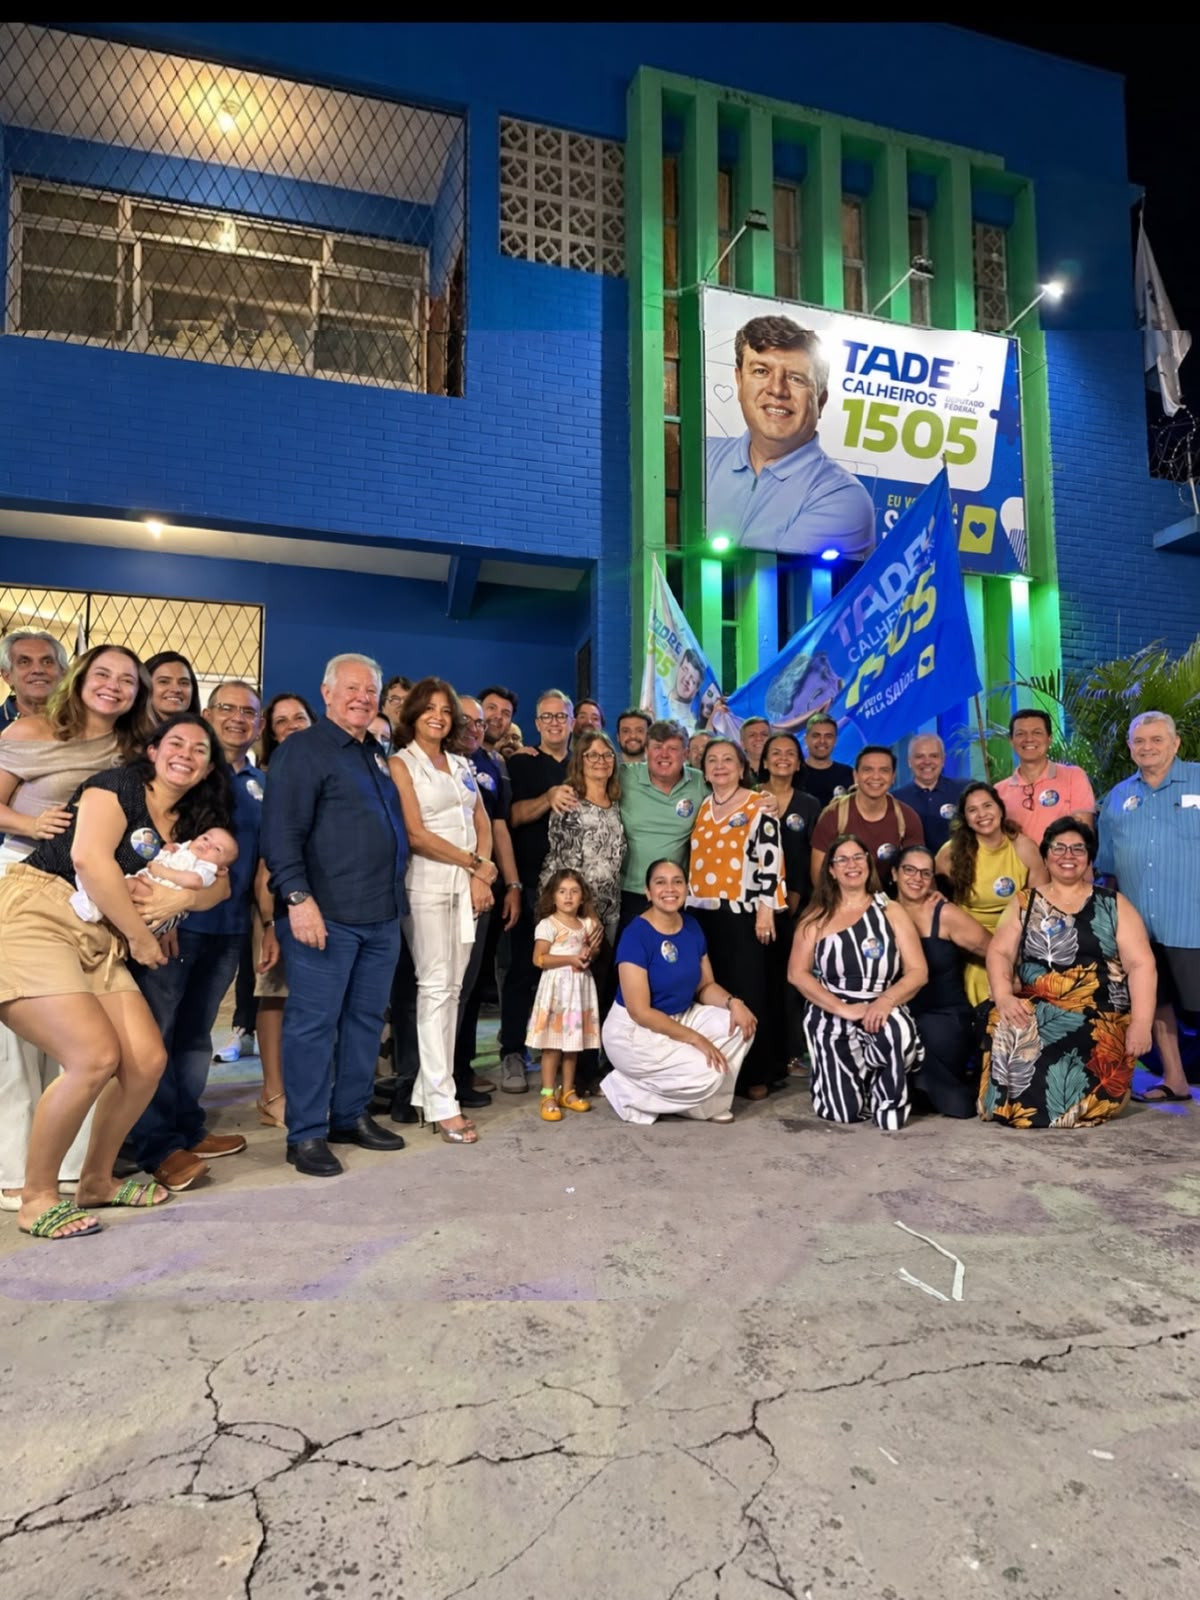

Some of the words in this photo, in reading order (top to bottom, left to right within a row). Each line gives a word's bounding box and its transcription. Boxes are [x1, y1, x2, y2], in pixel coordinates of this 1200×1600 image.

[842, 339, 955, 391] TADE
[842, 377, 937, 407] CALHEIROS
[945, 395, 985, 408] DEPUTADO
[944, 402, 977, 415] FEDERAL
[842, 398, 978, 466] 1505
[887, 494, 901, 508] EU
[830, 514, 936, 648] TADE
